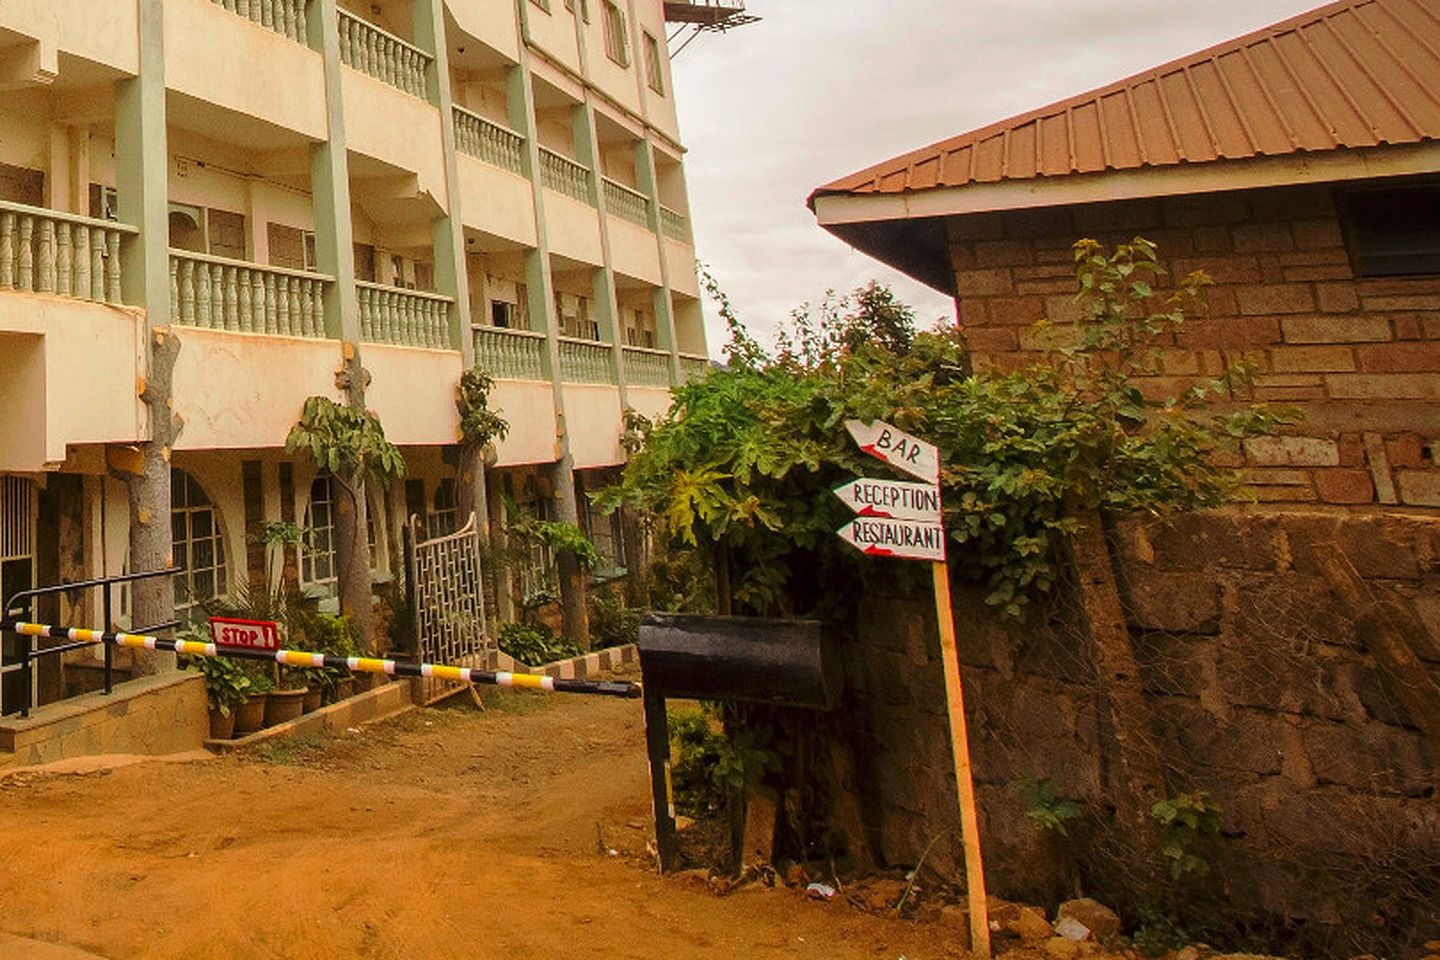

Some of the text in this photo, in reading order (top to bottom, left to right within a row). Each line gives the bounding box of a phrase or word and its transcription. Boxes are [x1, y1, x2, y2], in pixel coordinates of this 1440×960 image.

[876, 429, 921, 464] BAR
[853, 483, 939, 511] RECEPTION
[851, 521, 941, 550] RESTAURANT
